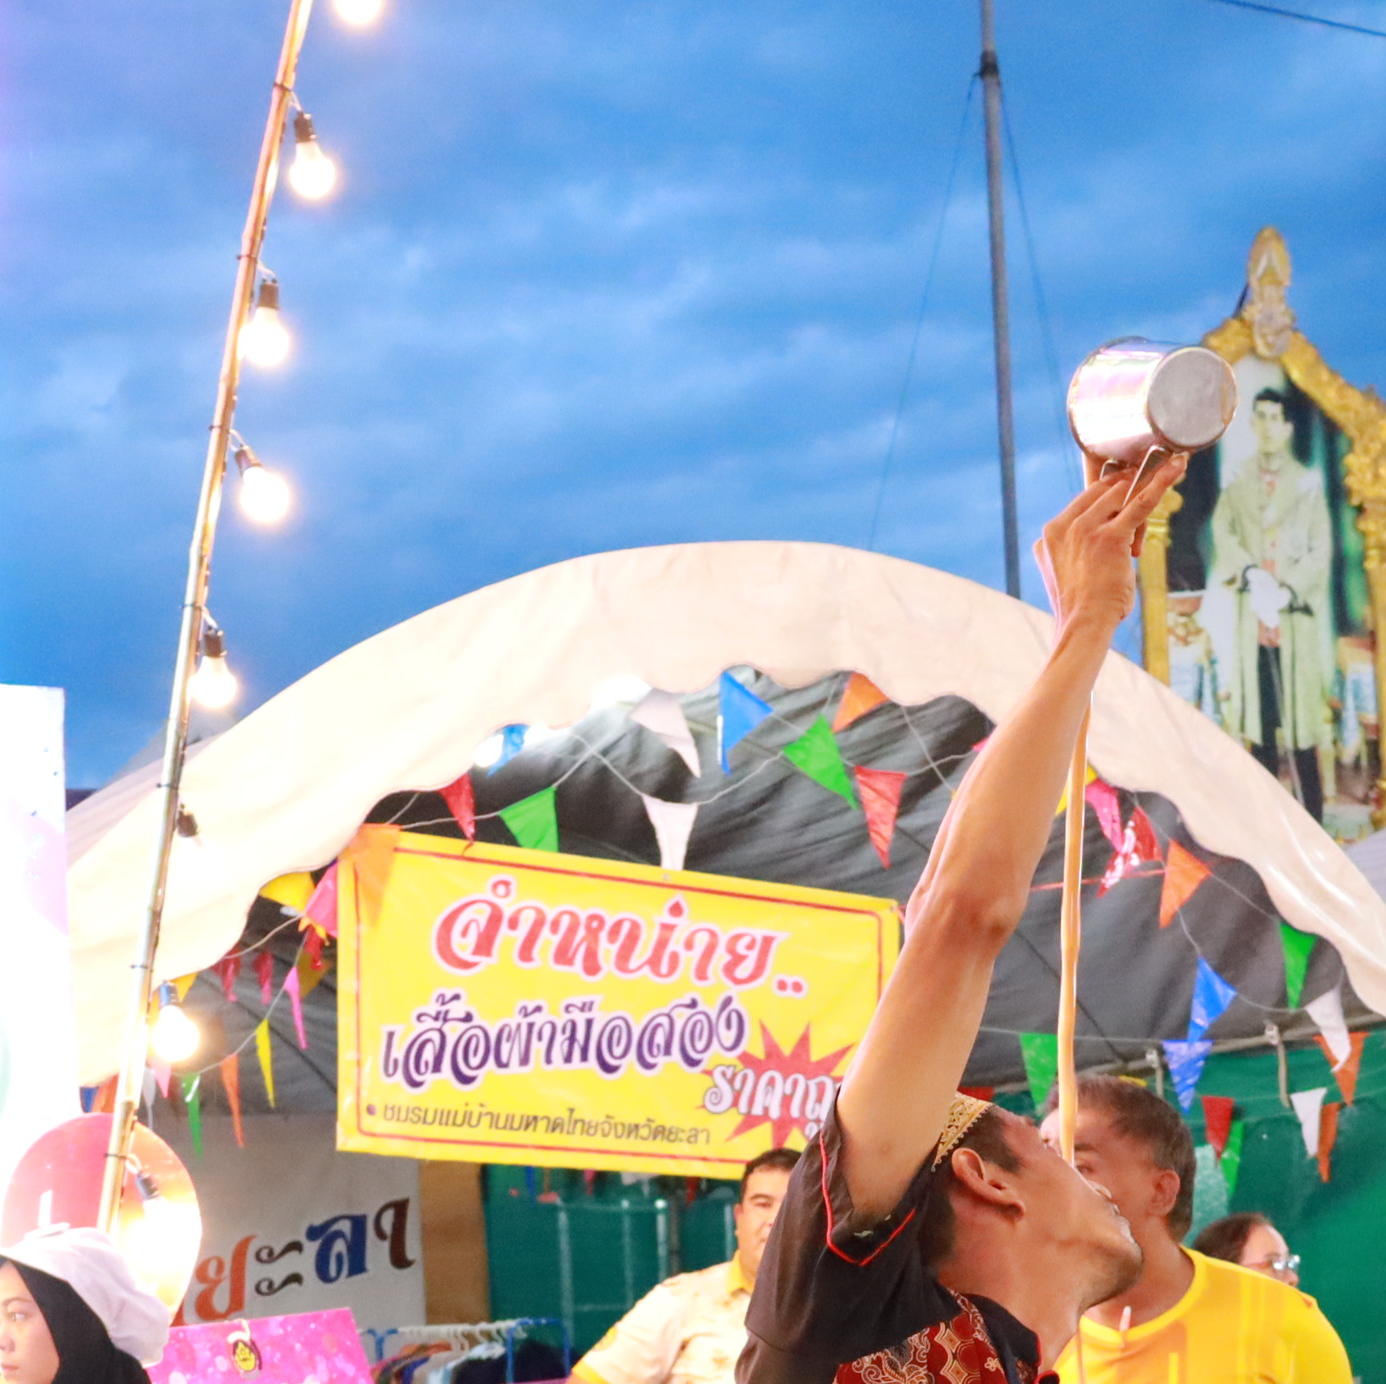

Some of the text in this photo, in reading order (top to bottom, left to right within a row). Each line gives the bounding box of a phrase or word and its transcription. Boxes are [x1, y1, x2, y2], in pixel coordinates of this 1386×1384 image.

[381, 991, 748, 1091] เสื้อผ้ามือสอง
[704, 1064, 840, 1139] ราคาถู
